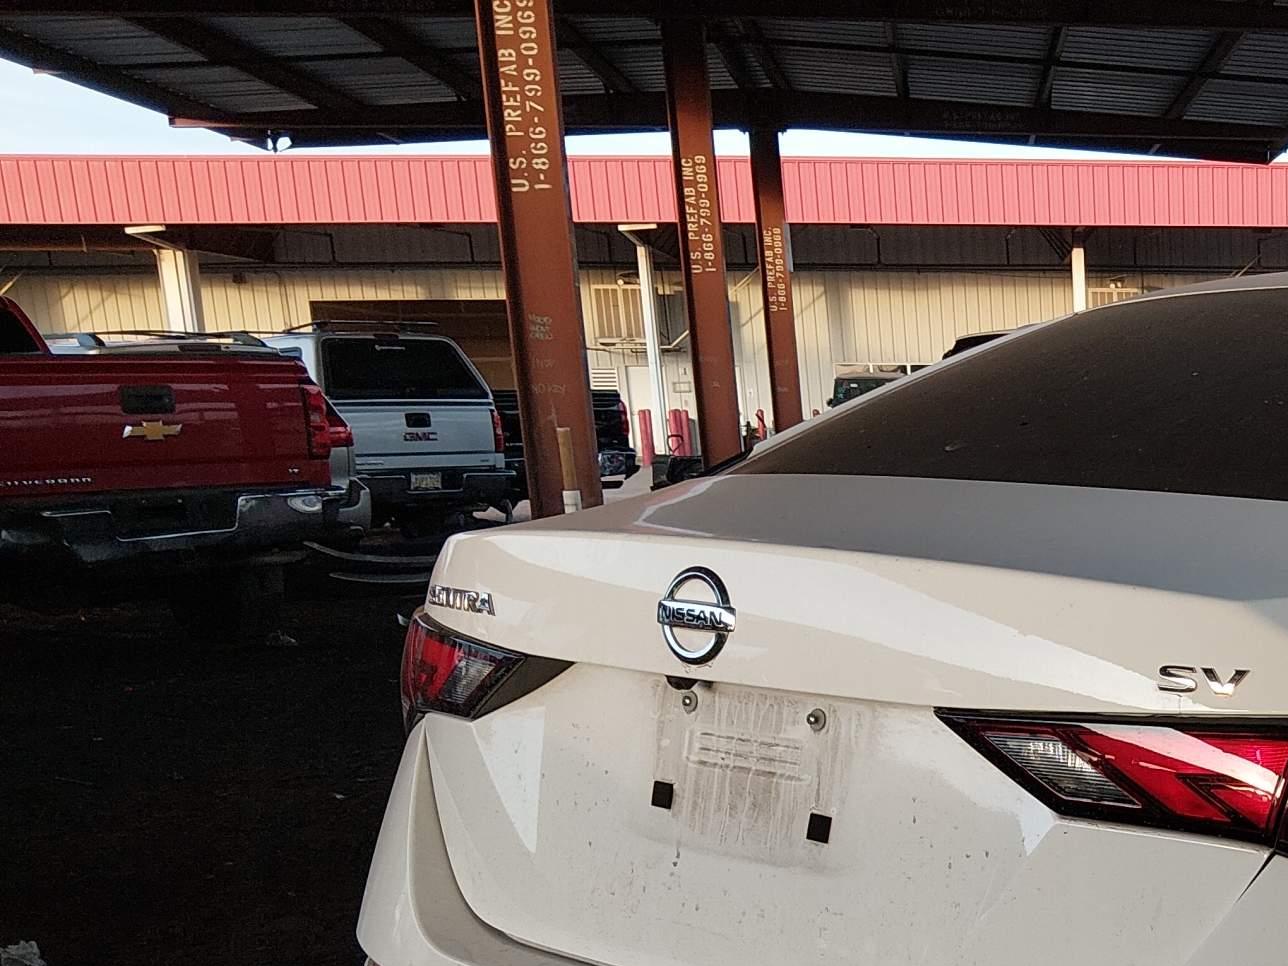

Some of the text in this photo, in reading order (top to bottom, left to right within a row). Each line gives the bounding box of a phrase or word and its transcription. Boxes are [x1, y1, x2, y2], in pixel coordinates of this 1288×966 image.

[498, 48, 525, 136] PREFAB
[508, 150, 530, 192] U.S.
[681, 158, 695, 180] INC
[684, 187, 700, 240] PREFAB
[694, 155, 717, 272] 1-866-799-0969
[764, 250, 777, 288] PREFAB
[403, 432, 438, 442] GMC
[661, 605, 723, 628] NISSAN
[1157, 665, 1251, 697] SV
